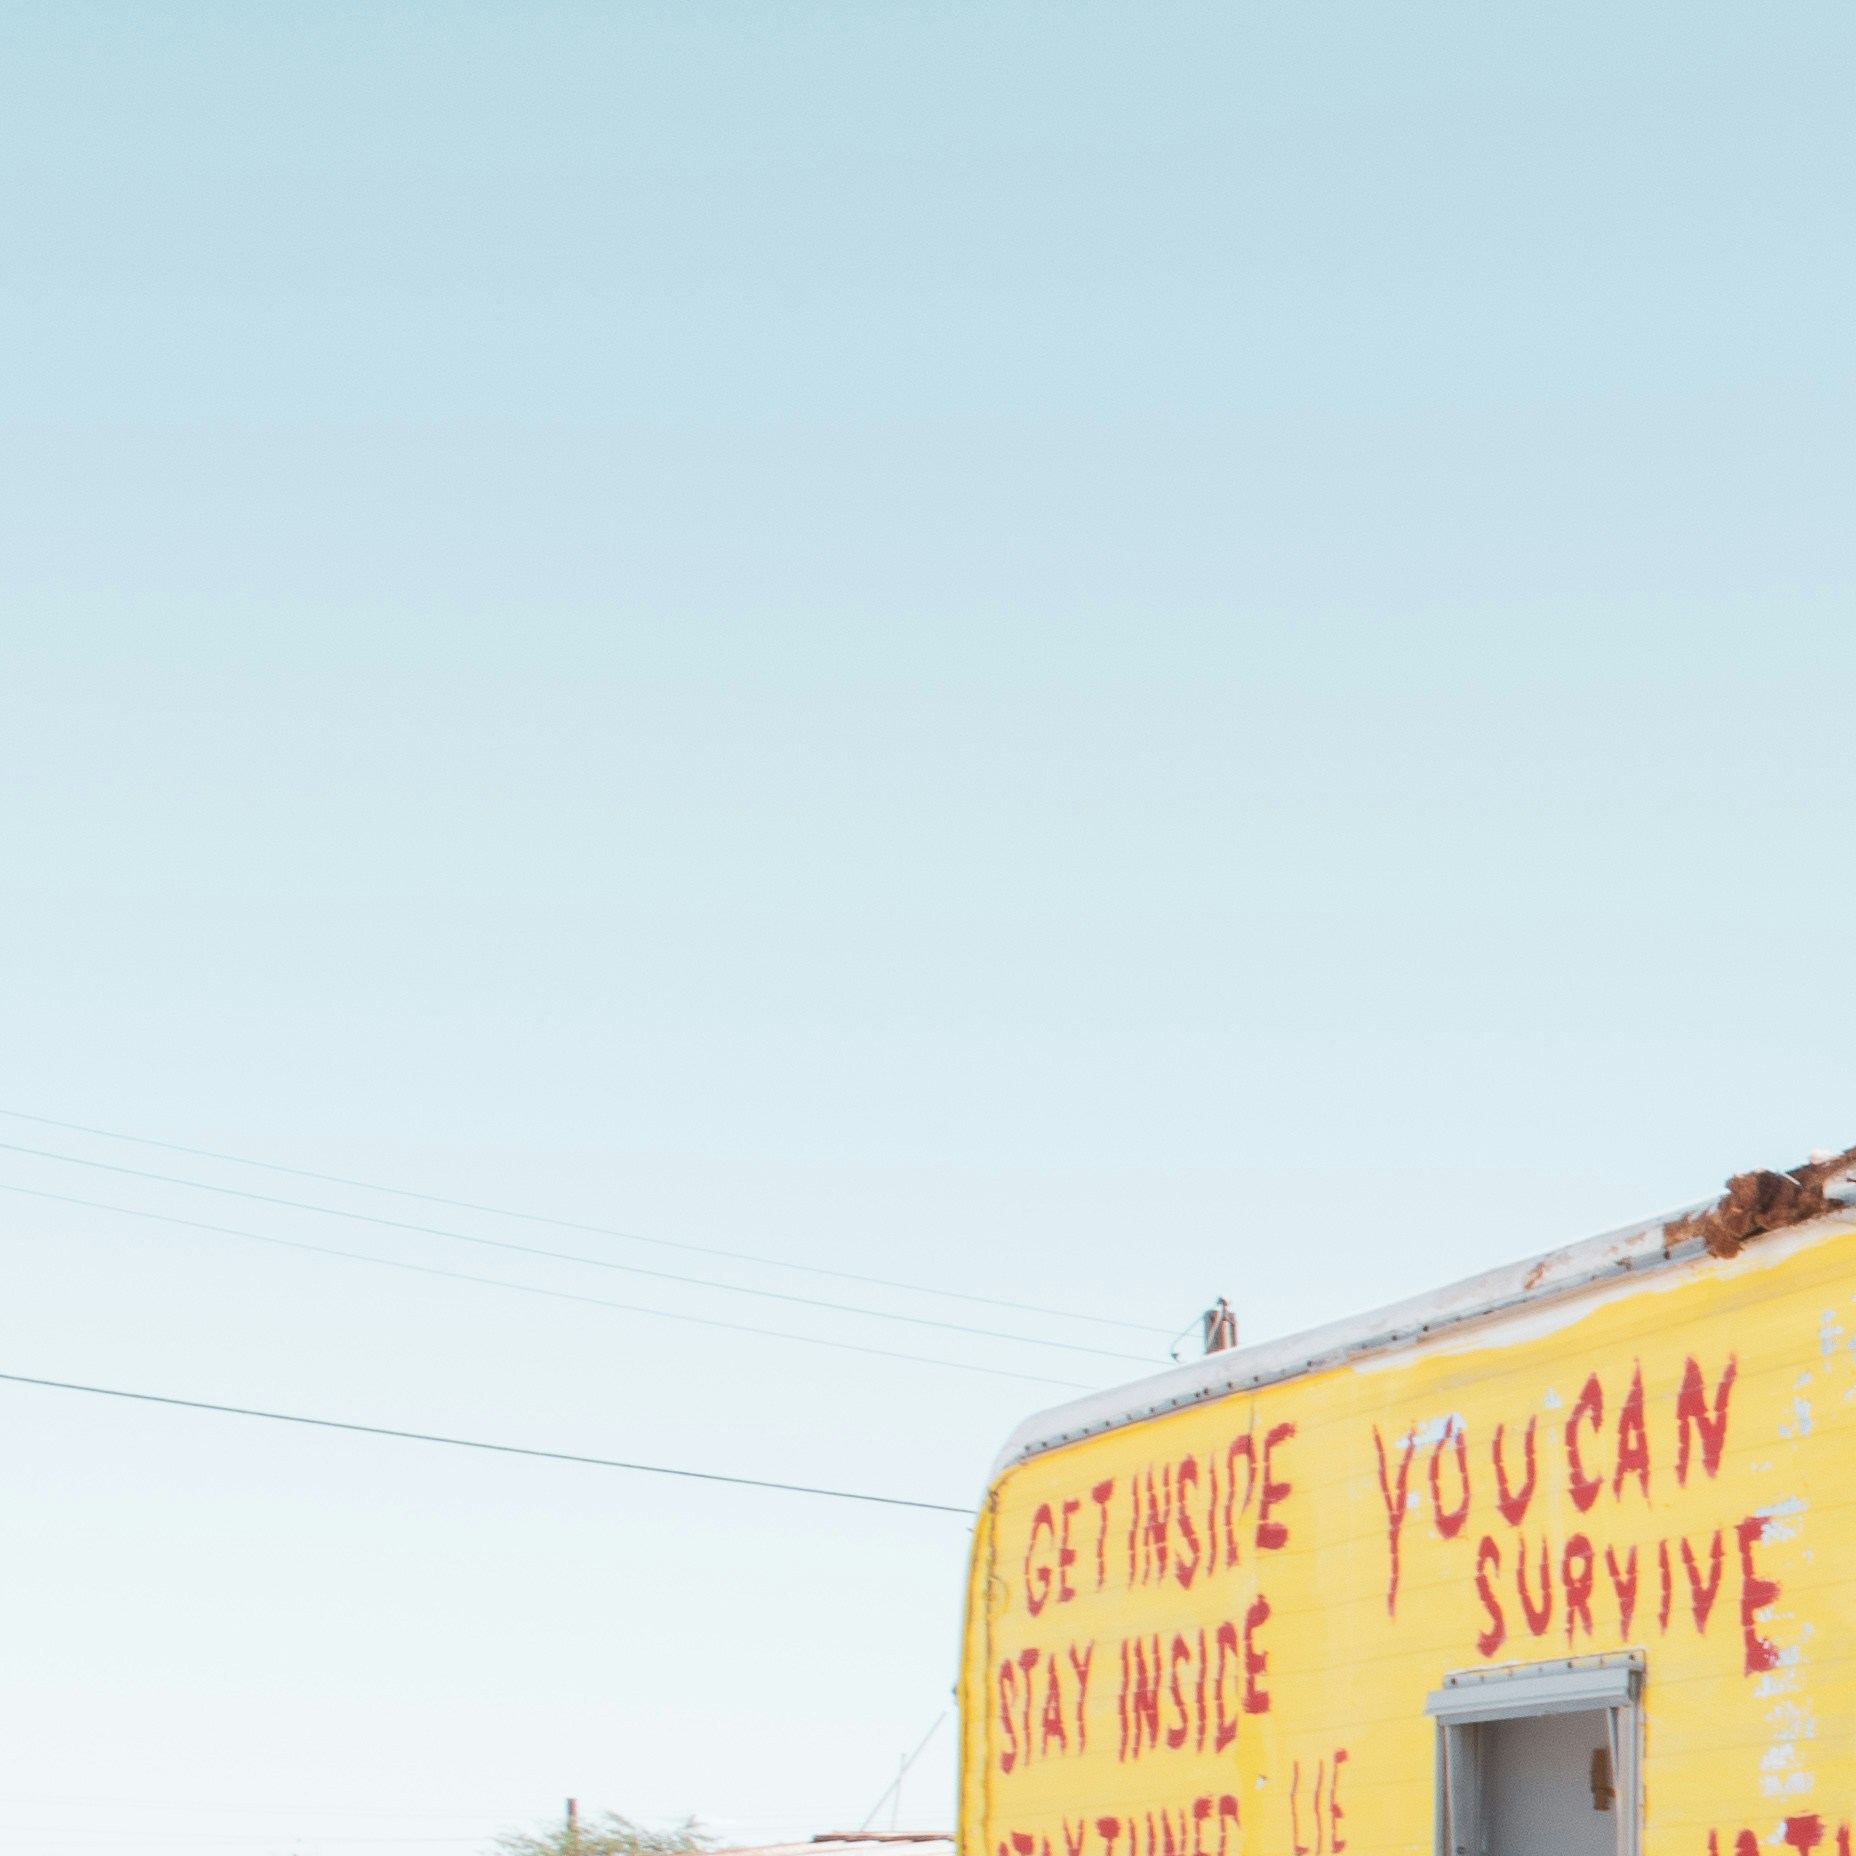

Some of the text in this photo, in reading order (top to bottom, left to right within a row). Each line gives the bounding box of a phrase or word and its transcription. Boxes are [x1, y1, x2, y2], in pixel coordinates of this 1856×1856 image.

[1023, 1422, 1298, 1617] GET INSIDE
[1371, 1352, 1737, 1619] YOU CAN
[998, 1594, 1271, 1775] STAY INSIDE
[1474, 1515, 1783, 1678] SURVIVE
